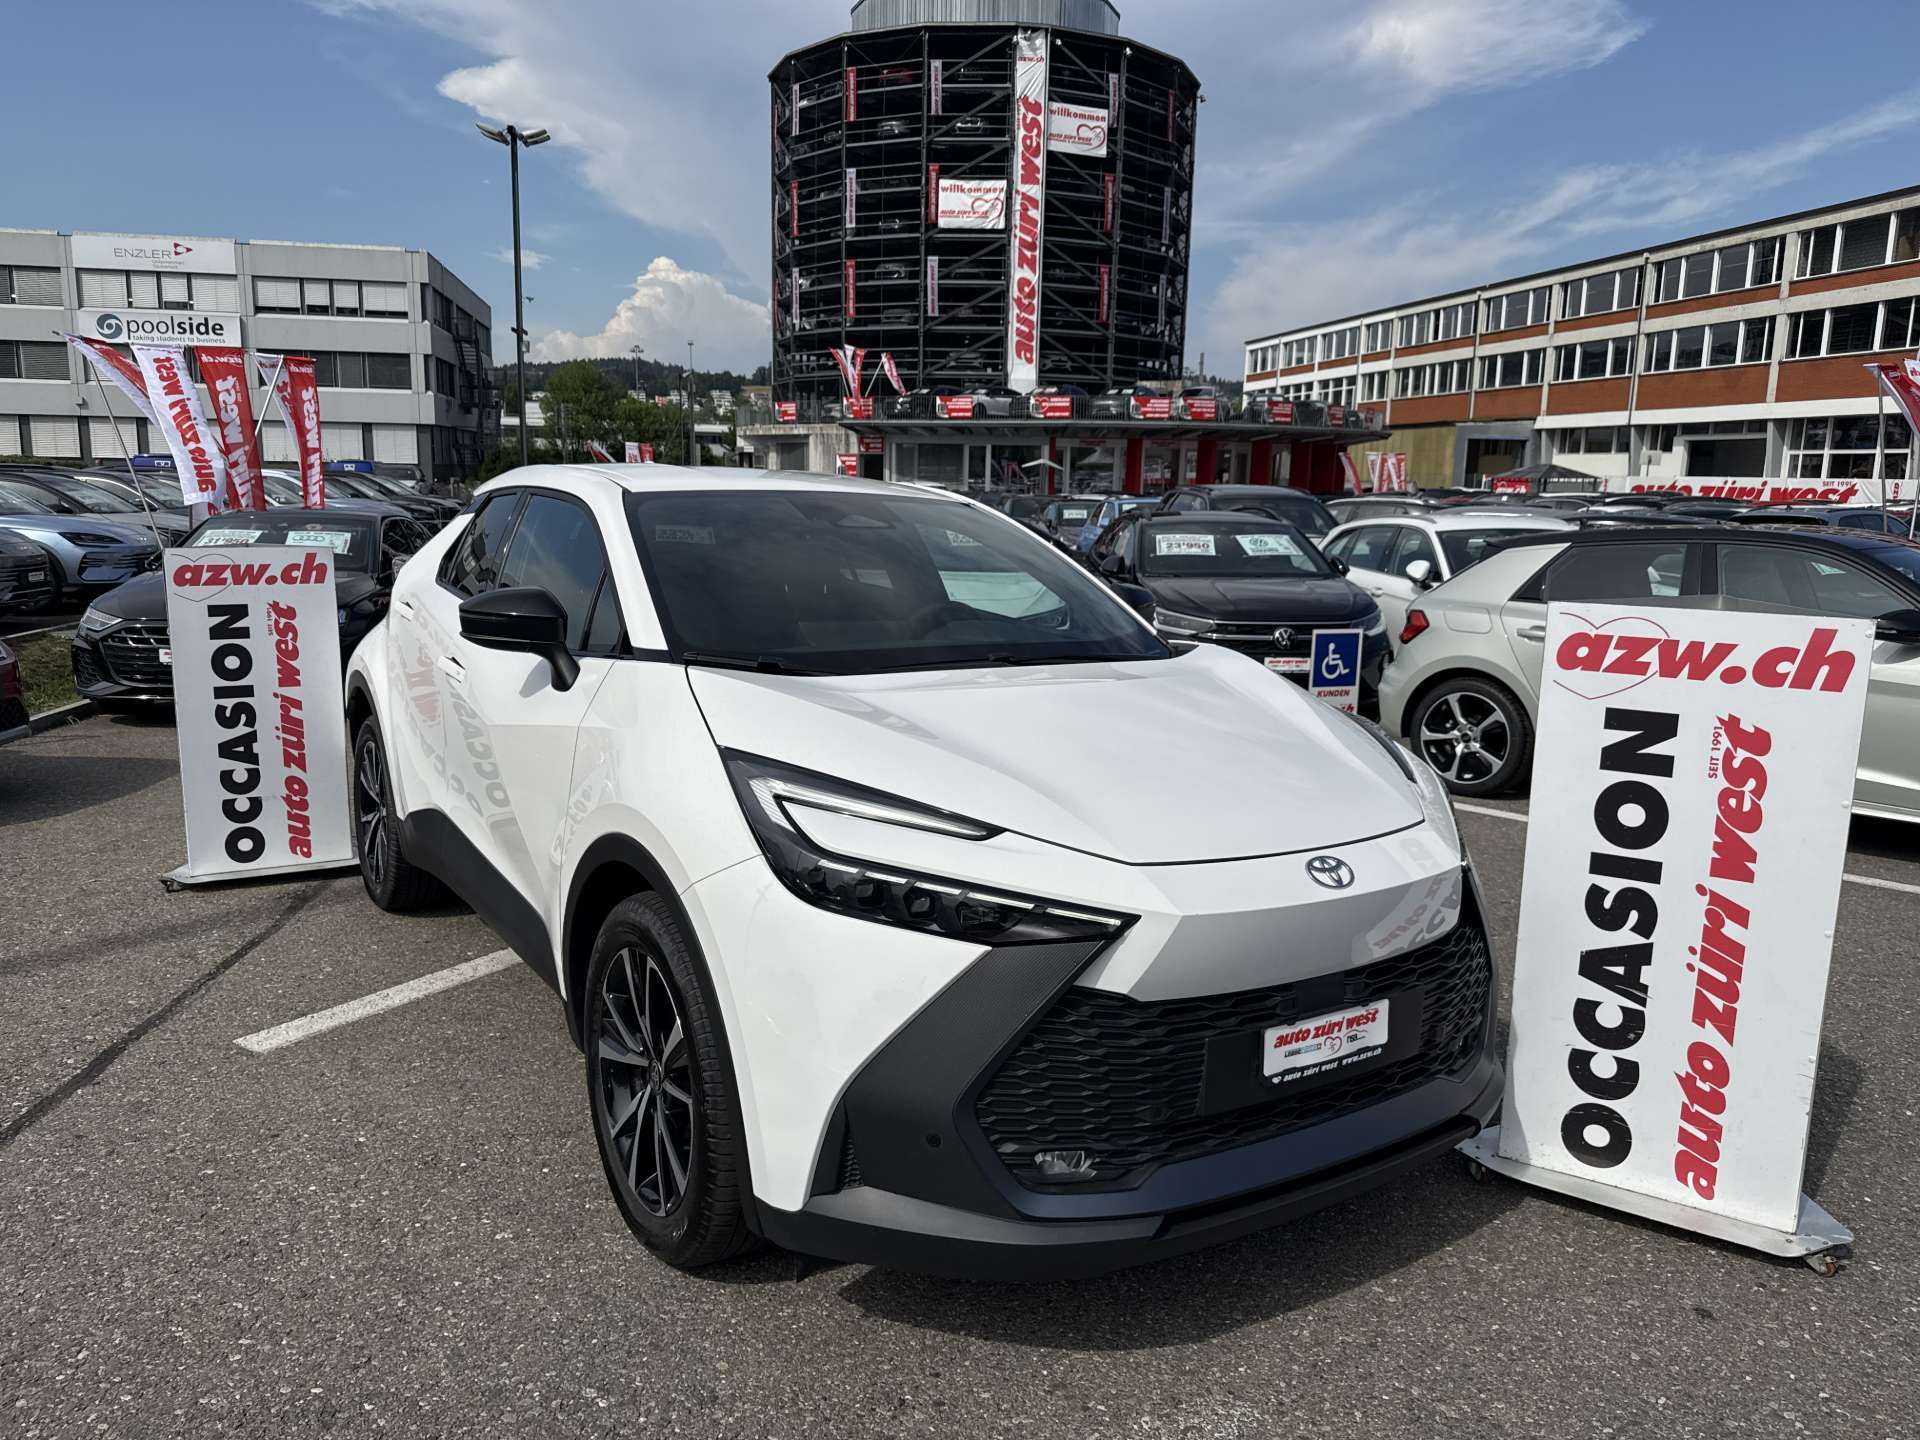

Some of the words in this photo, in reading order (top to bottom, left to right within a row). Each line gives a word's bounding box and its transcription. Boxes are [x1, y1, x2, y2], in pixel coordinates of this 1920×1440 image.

[1019, 95, 1043, 185] west
[1049, 106, 1106, 122] willkommen
[113, 247, 172, 259] ENZLER
[1014, 188, 1039, 276] züri
[126, 316, 225, 340] poolside
[133, 335, 155, 343] taking
[156, 335, 186, 343] students
[1013, 277, 1036, 365] auto
[172, 552, 328, 588] azw.ch
[267, 600, 301, 689] west
[1554, 627, 1856, 694] azw.ch
[207, 603, 266, 864] OCCASION
[272, 691, 307, 774] züri
[1316, 689, 1351, 698] KUNDEN
[1708, 756, 1719, 780] SEIT
[1711, 725, 1724, 751] 1991
[280, 774, 313, 860] auto
[1708, 713, 1773, 884] west
[1559, 706, 1681, 1169] OCCASION
[1685, 882, 1752, 1048] züri
[1273, 1027, 1311, 1049] auto
[1312, 1015, 1345, 1040] züri
[1345, 1007, 1379, 1031] west
[1673, 1041, 1731, 1202] auto
